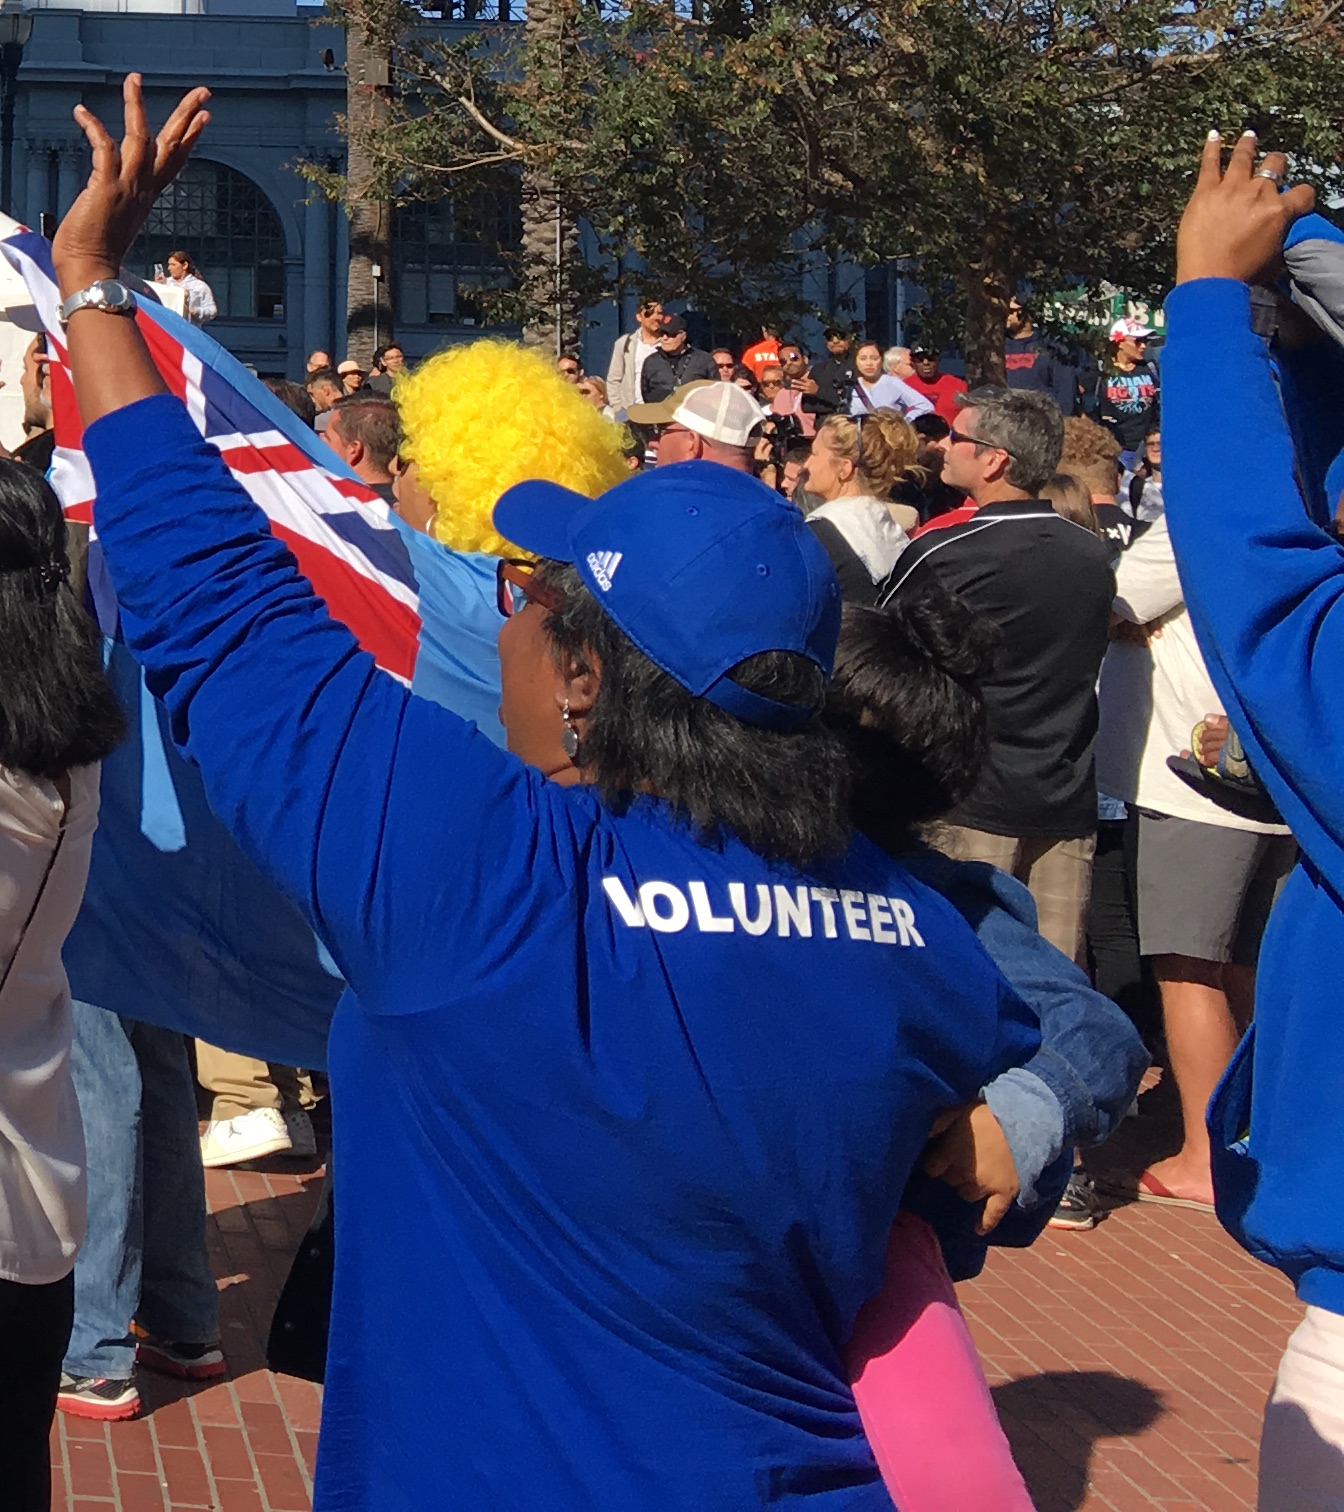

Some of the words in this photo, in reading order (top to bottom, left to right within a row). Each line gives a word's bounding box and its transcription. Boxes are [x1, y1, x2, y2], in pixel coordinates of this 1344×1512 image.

[755, 352, 779, 361] STA
[587, 552, 612, 592] adidas
[601, 875, 926, 948] VOLUNTEER
